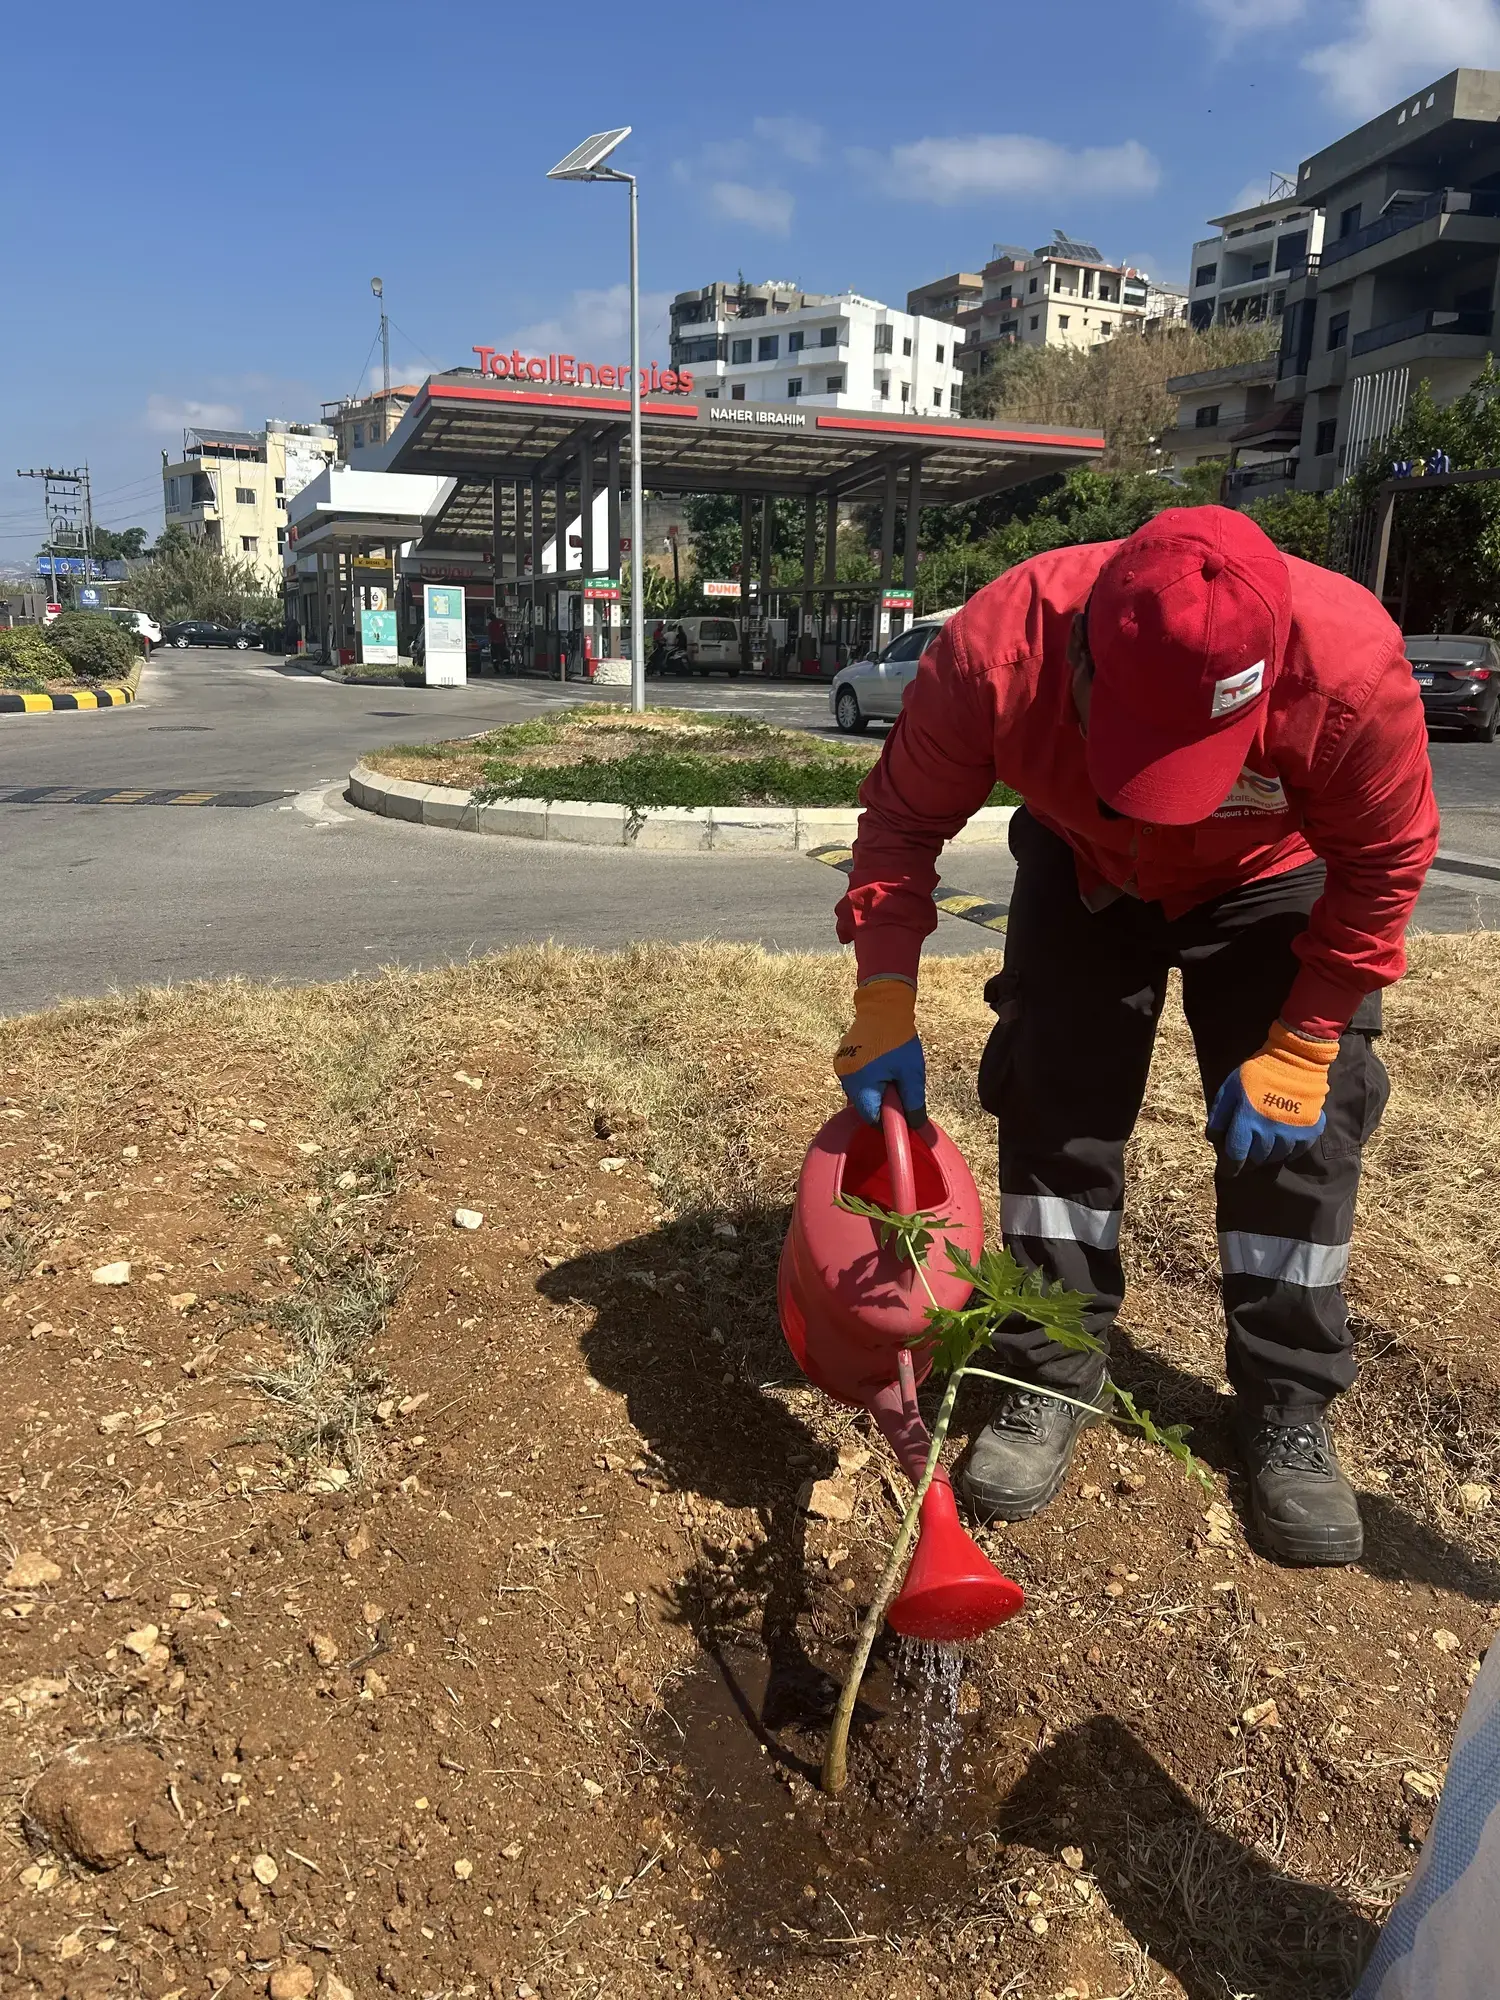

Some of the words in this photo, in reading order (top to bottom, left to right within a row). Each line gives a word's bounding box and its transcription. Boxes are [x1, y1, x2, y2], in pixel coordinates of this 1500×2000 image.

[472, 345, 694, 397] TotalEnergies
[710, 407, 753, 422] NAHER
[756, 411, 806, 426] IBRAHIM
[1392, 449, 1451, 479] wash
[623, 540, 630, 550] 2
[485, 555, 491, 563] 3
[873, 550, 879, 560] 5
[420, 562, 476, 580] bonjour
[1262, 1092, 1302, 1115] 300#
